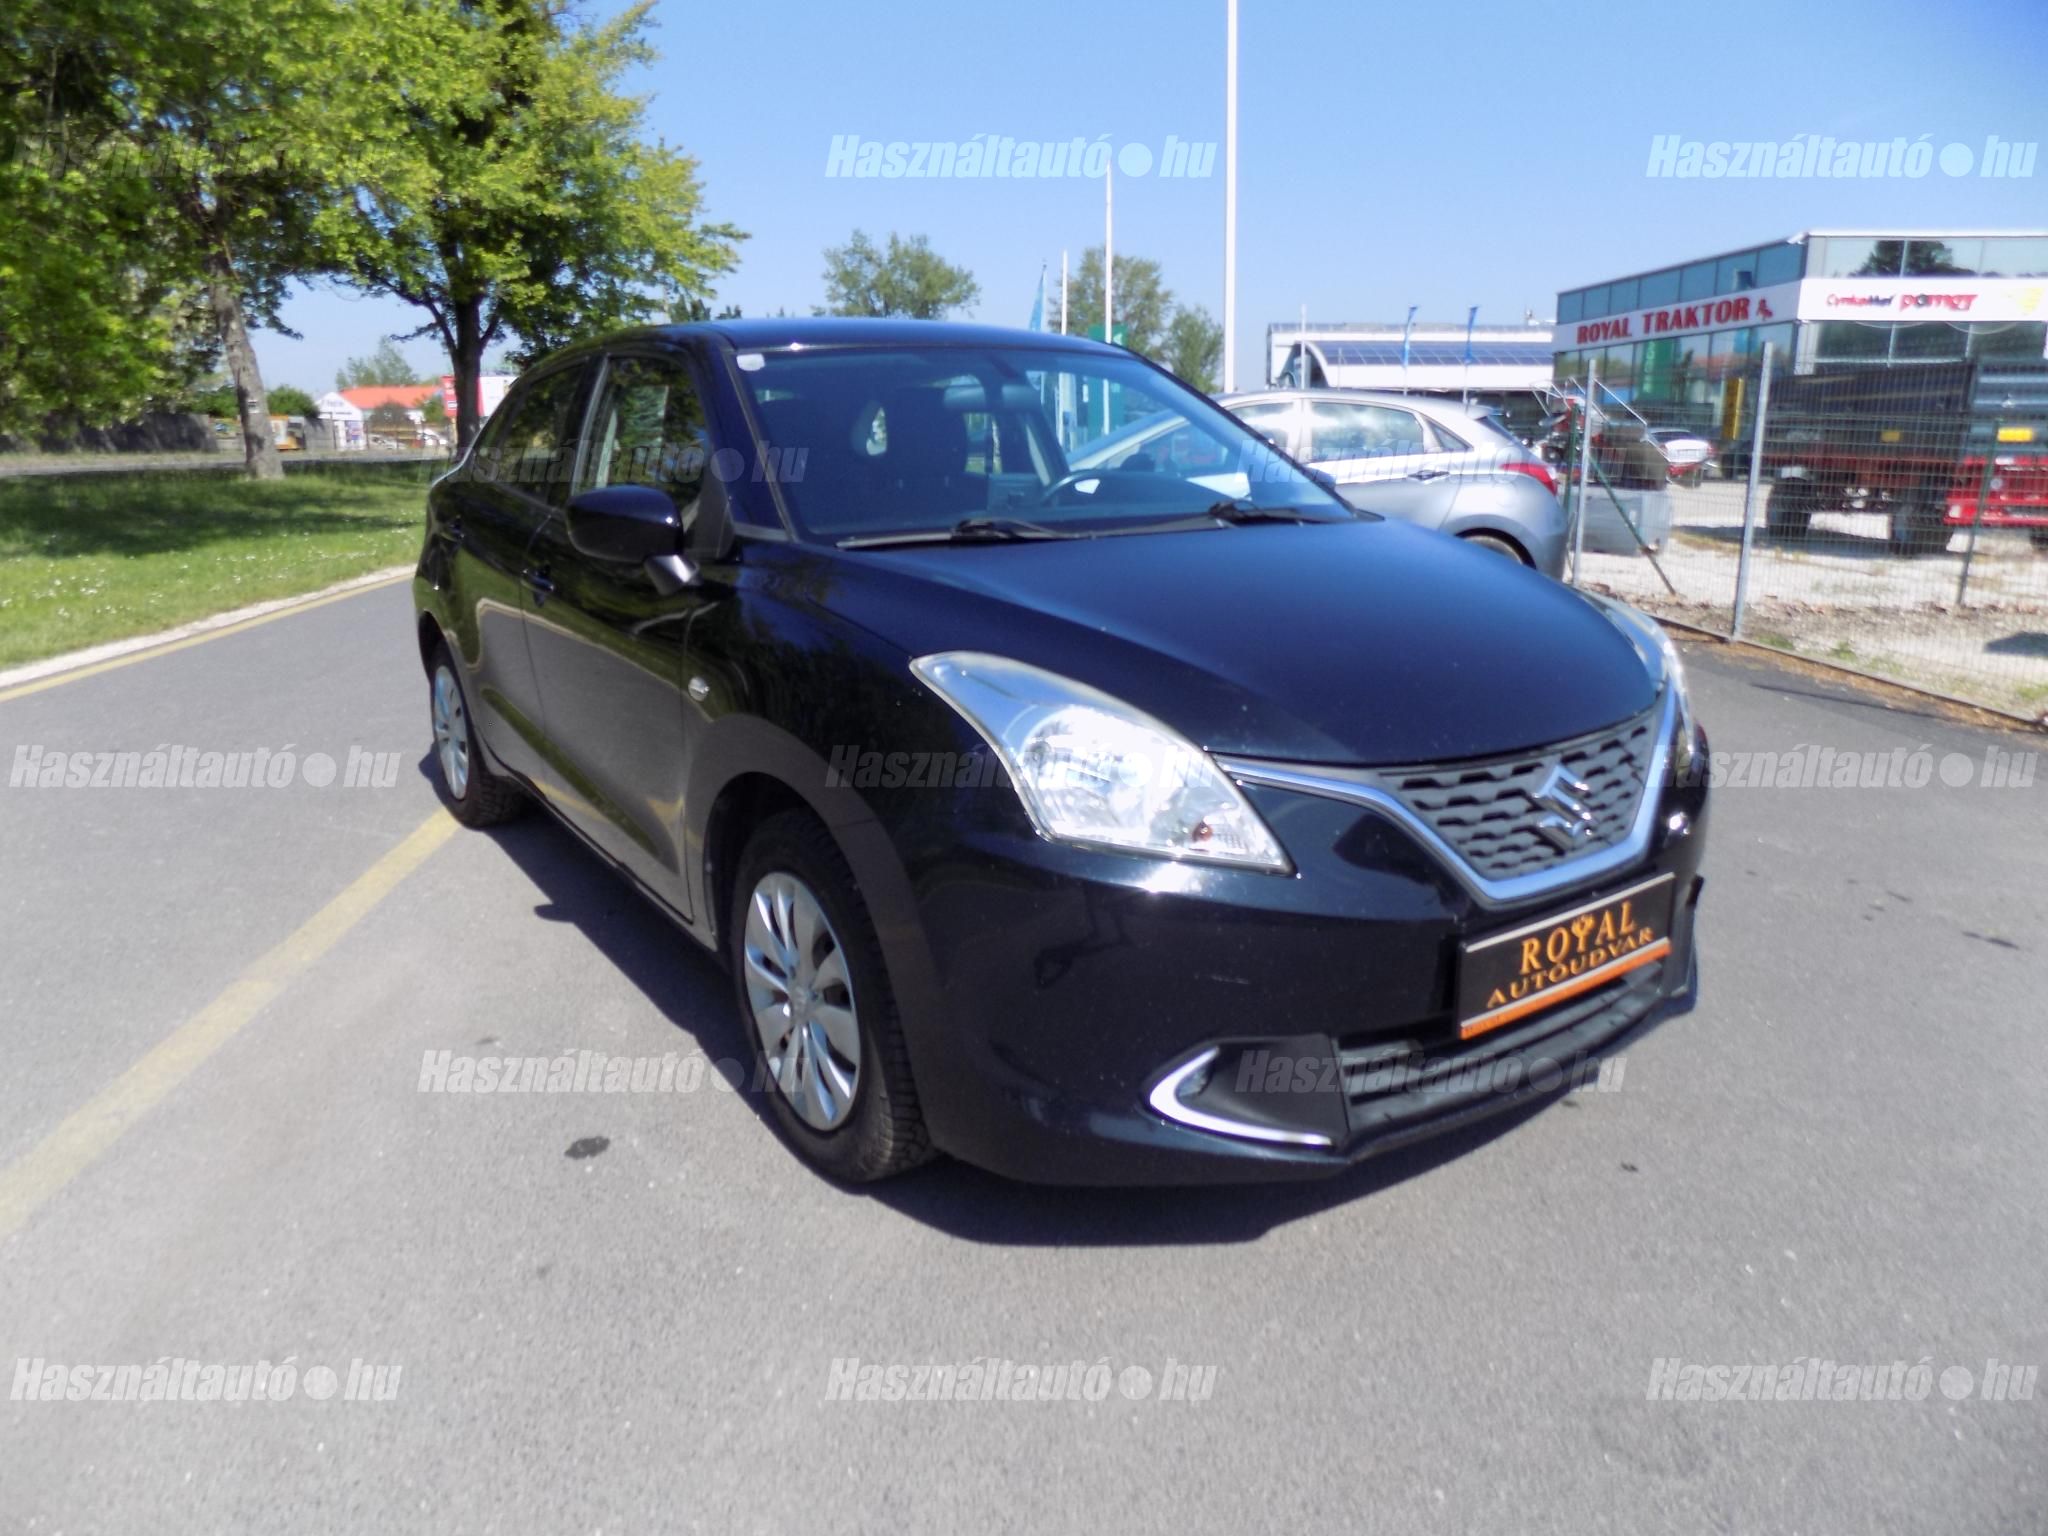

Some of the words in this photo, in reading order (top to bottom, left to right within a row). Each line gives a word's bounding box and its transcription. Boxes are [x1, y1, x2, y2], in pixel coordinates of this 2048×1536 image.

[1576, 317, 1632, 344] ROYAL
[1641, 297, 1751, 334] TRAKTOR
[1520, 900, 1636, 975] ROYAL
